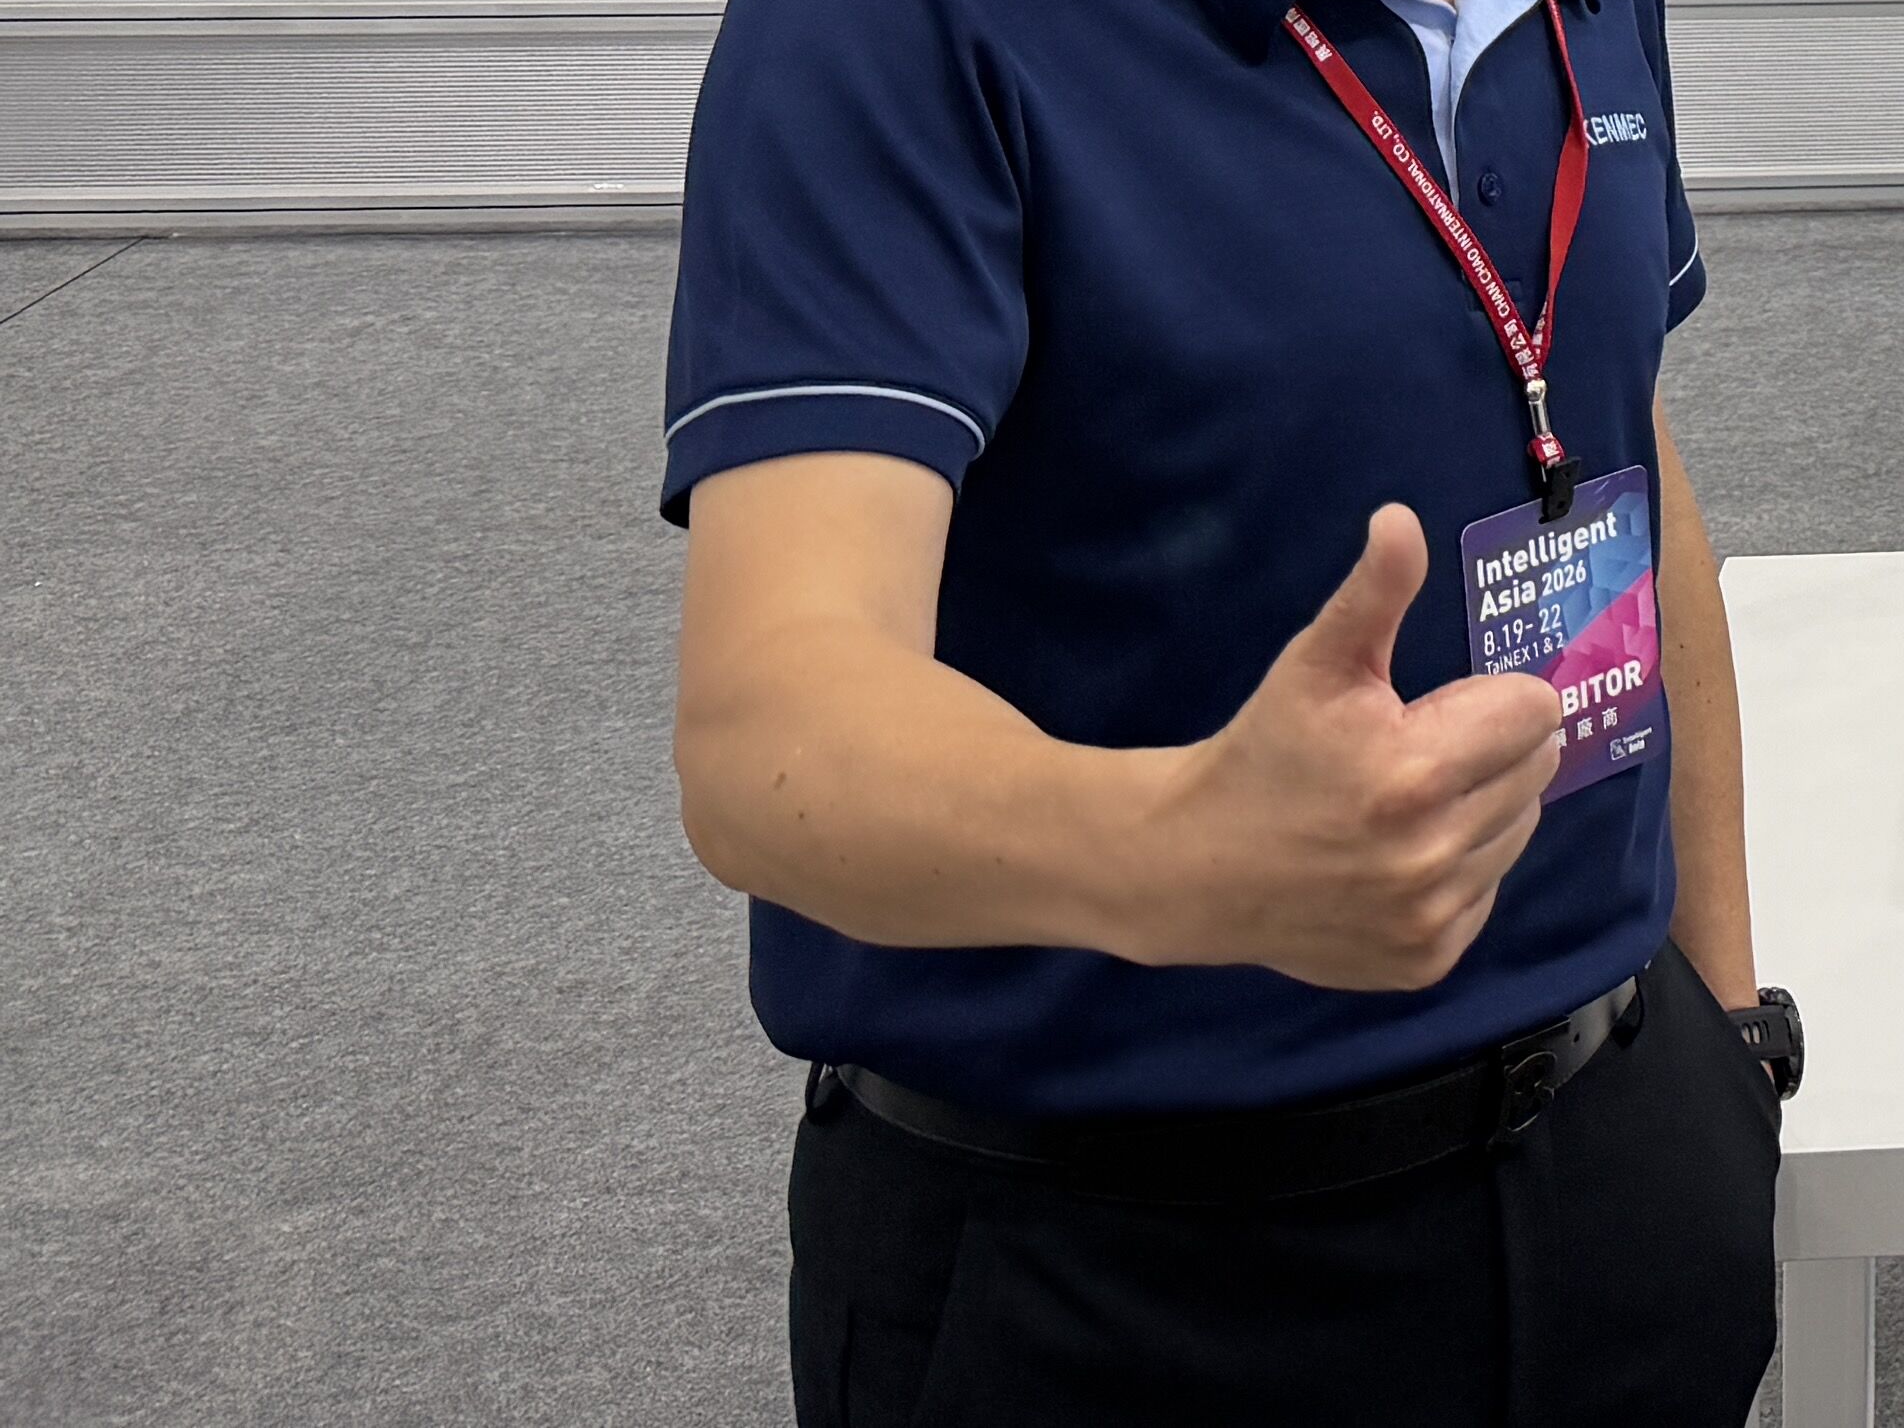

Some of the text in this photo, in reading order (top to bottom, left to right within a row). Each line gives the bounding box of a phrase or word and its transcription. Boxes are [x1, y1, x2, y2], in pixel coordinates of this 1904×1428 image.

[1407, 161, 1473, 252] INTERNATIONAL
[1467, 248, 1492, 284] CHAO
[1486, 279, 1511, 318] CHAN
[1476, 512, 1617, 588] Intelligent
[1479, 559, 1587, 622] Asia 2026
[1485, 631, 1564, 676] TaiNEX 1 & 2
[1560, 659, 1643, 717] BITOR
